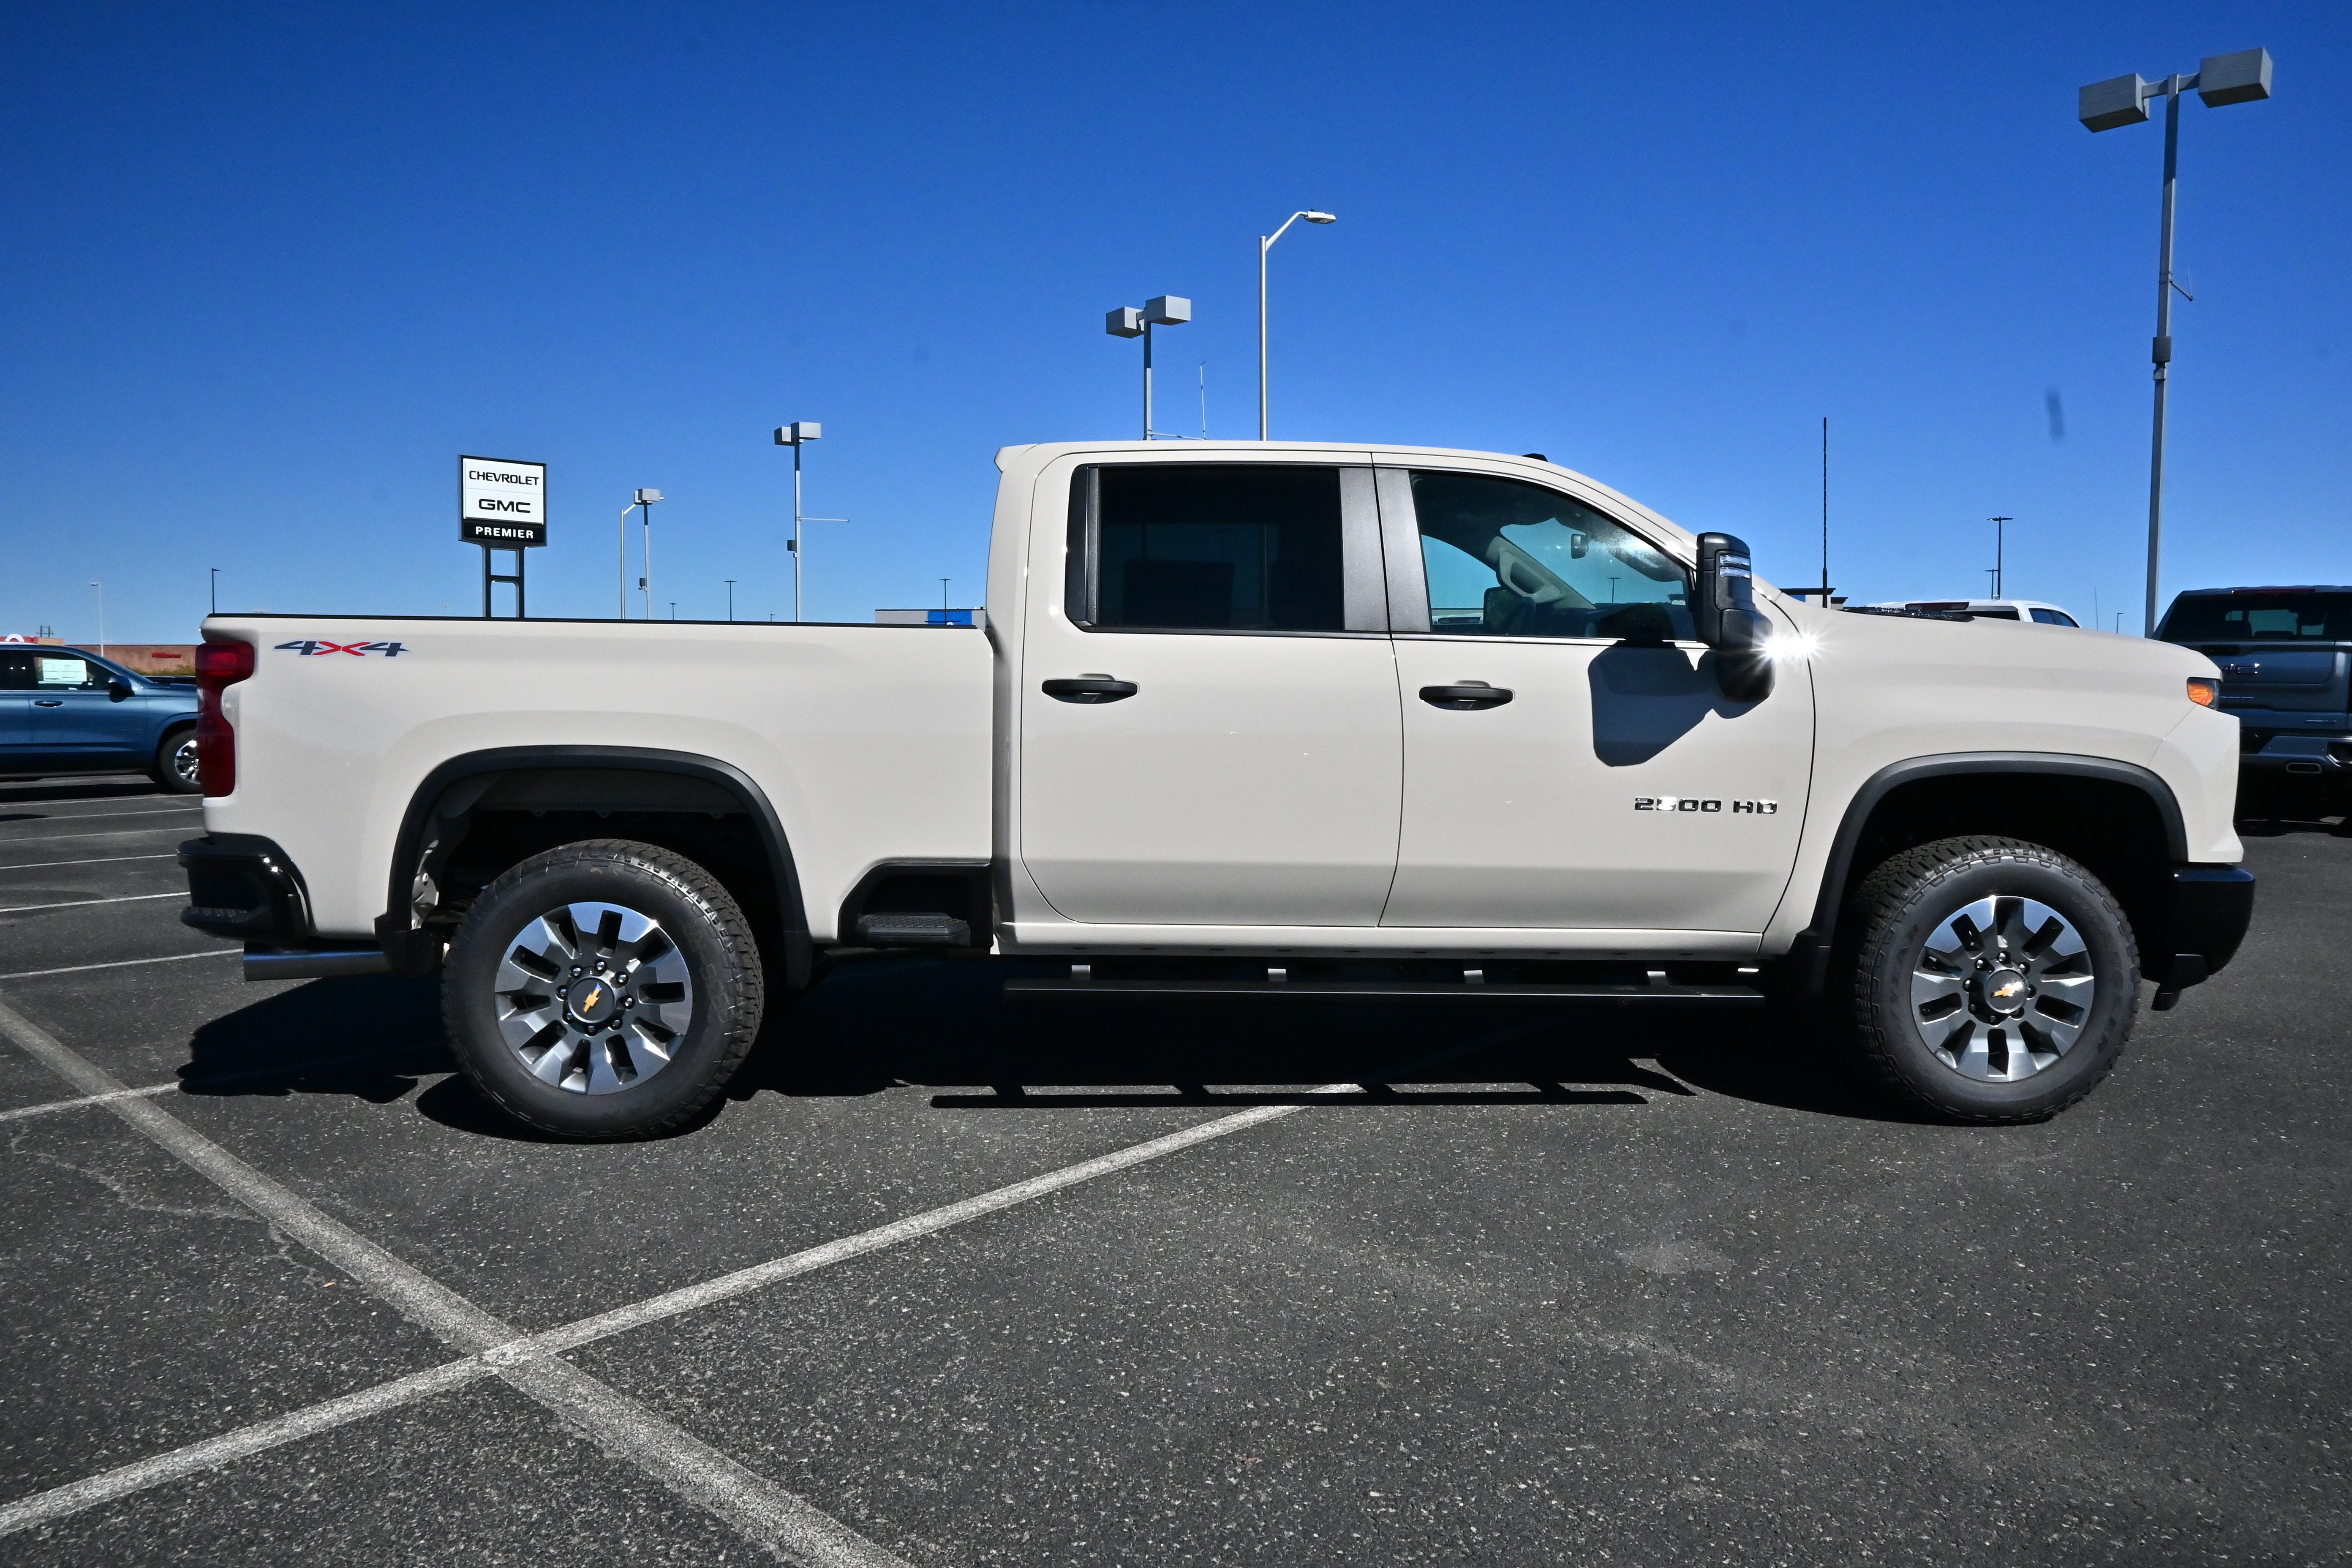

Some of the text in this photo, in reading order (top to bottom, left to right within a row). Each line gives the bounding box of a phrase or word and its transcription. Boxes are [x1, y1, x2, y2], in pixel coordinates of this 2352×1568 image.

[469, 470, 539, 485] CHEVROLET
[479, 498, 531, 513] GMC
[475, 526, 534, 539] PREMIER
[1634, 797, 1777, 814] 2500 HD
